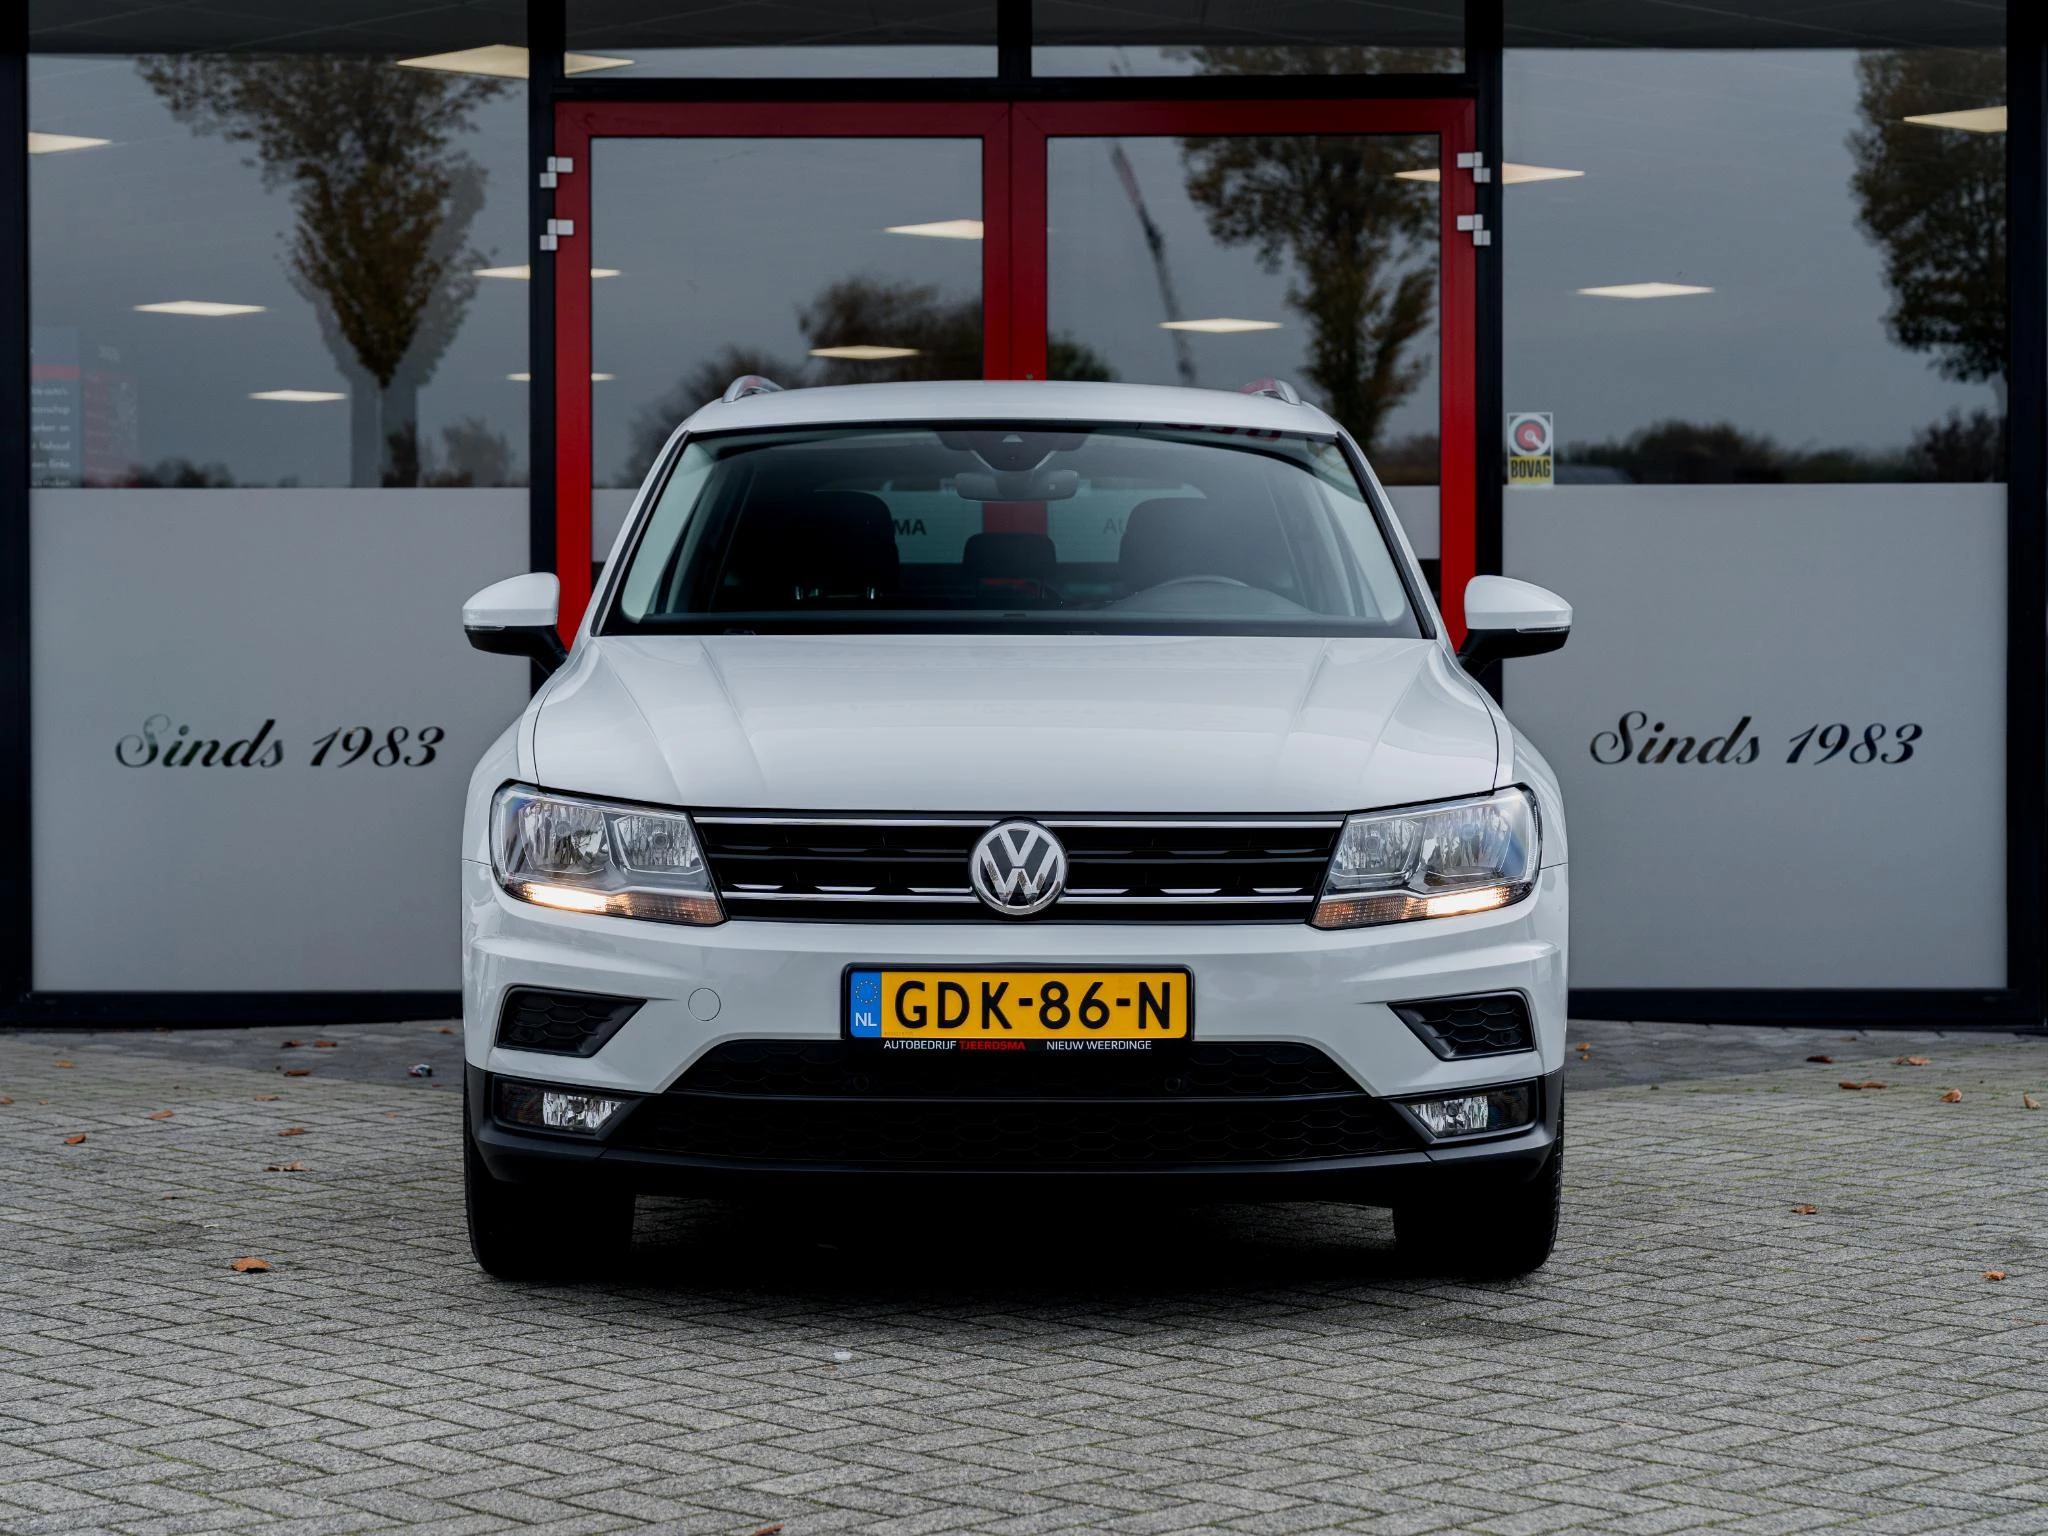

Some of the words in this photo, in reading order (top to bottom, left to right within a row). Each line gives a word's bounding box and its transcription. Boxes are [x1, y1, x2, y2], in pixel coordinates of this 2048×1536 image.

[1511, 459, 1550, 478] BOVAG
[115, 713, 284, 768] Sinds
[310, 726, 446, 768] 1983
[1590, 710, 1760, 765] Sinds
[1786, 723, 1923, 765] 1983
[855, 1012, 877, 1027] NL
[894, 980, 1171, 1030] GDK-86-N
[883, 1040, 957, 1051] AUTOBEDRIJF
[959, 1040, 1026, 1051] TJEERDSMA
[1046, 1040, 1084, 1051] NIEUW
[1086, 1040, 1152, 1051] WEERDINGE
